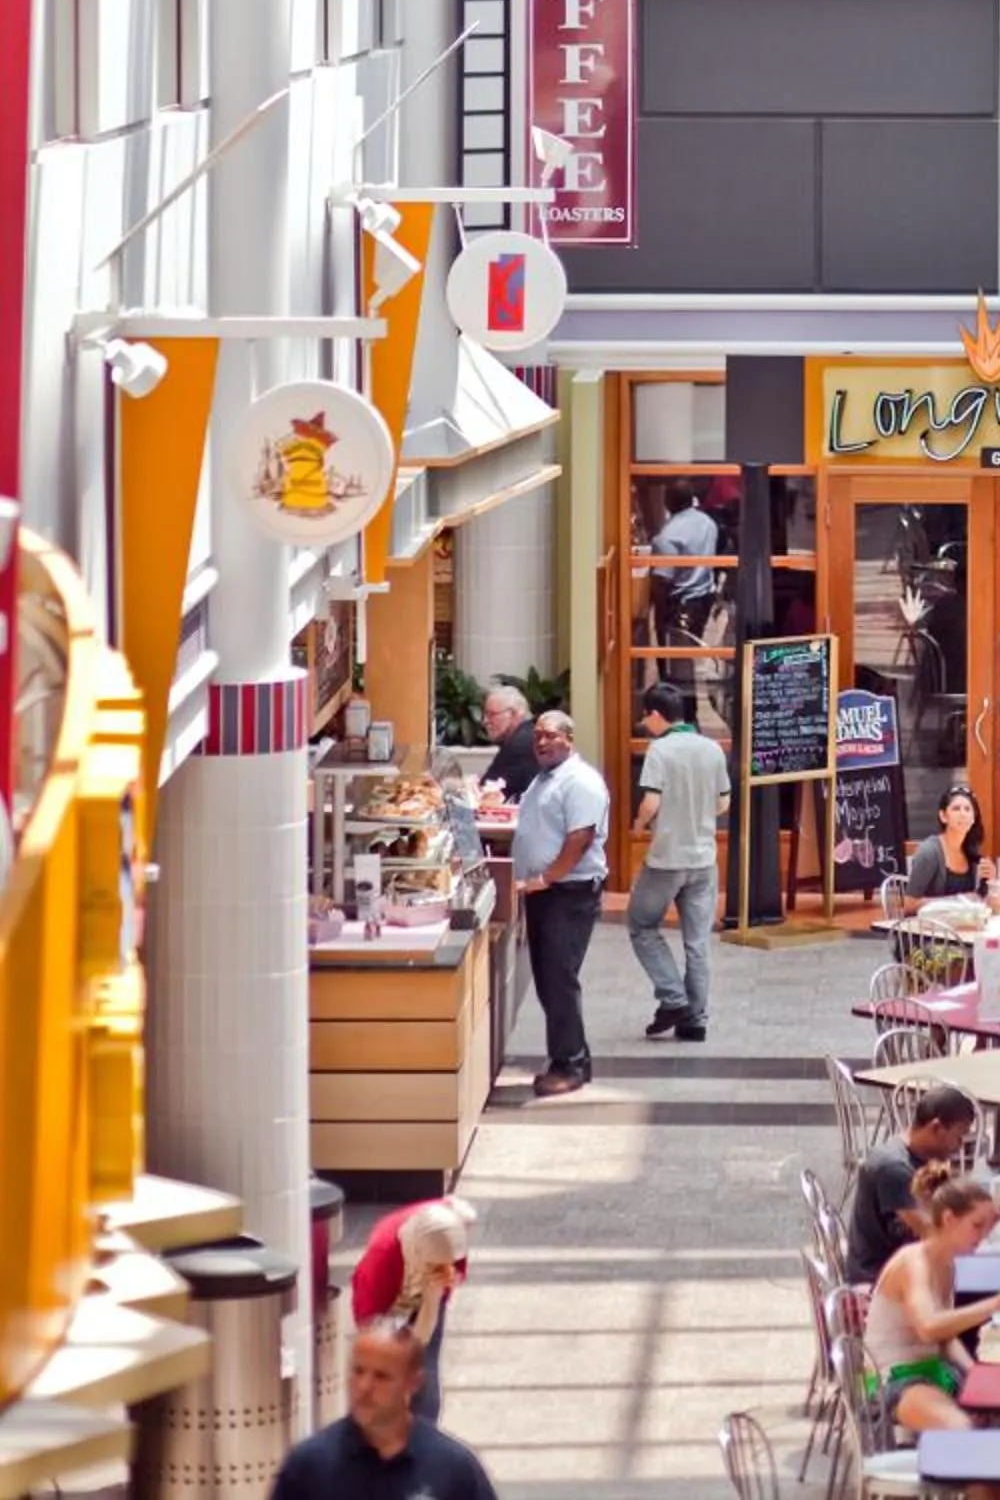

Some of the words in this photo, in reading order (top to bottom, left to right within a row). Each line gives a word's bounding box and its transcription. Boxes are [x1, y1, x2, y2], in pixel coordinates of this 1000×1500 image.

[541, 207, 625, 222] OASTERS
[836, 702, 888, 723] AMUEL
[836, 721, 883, 742] DAMS
